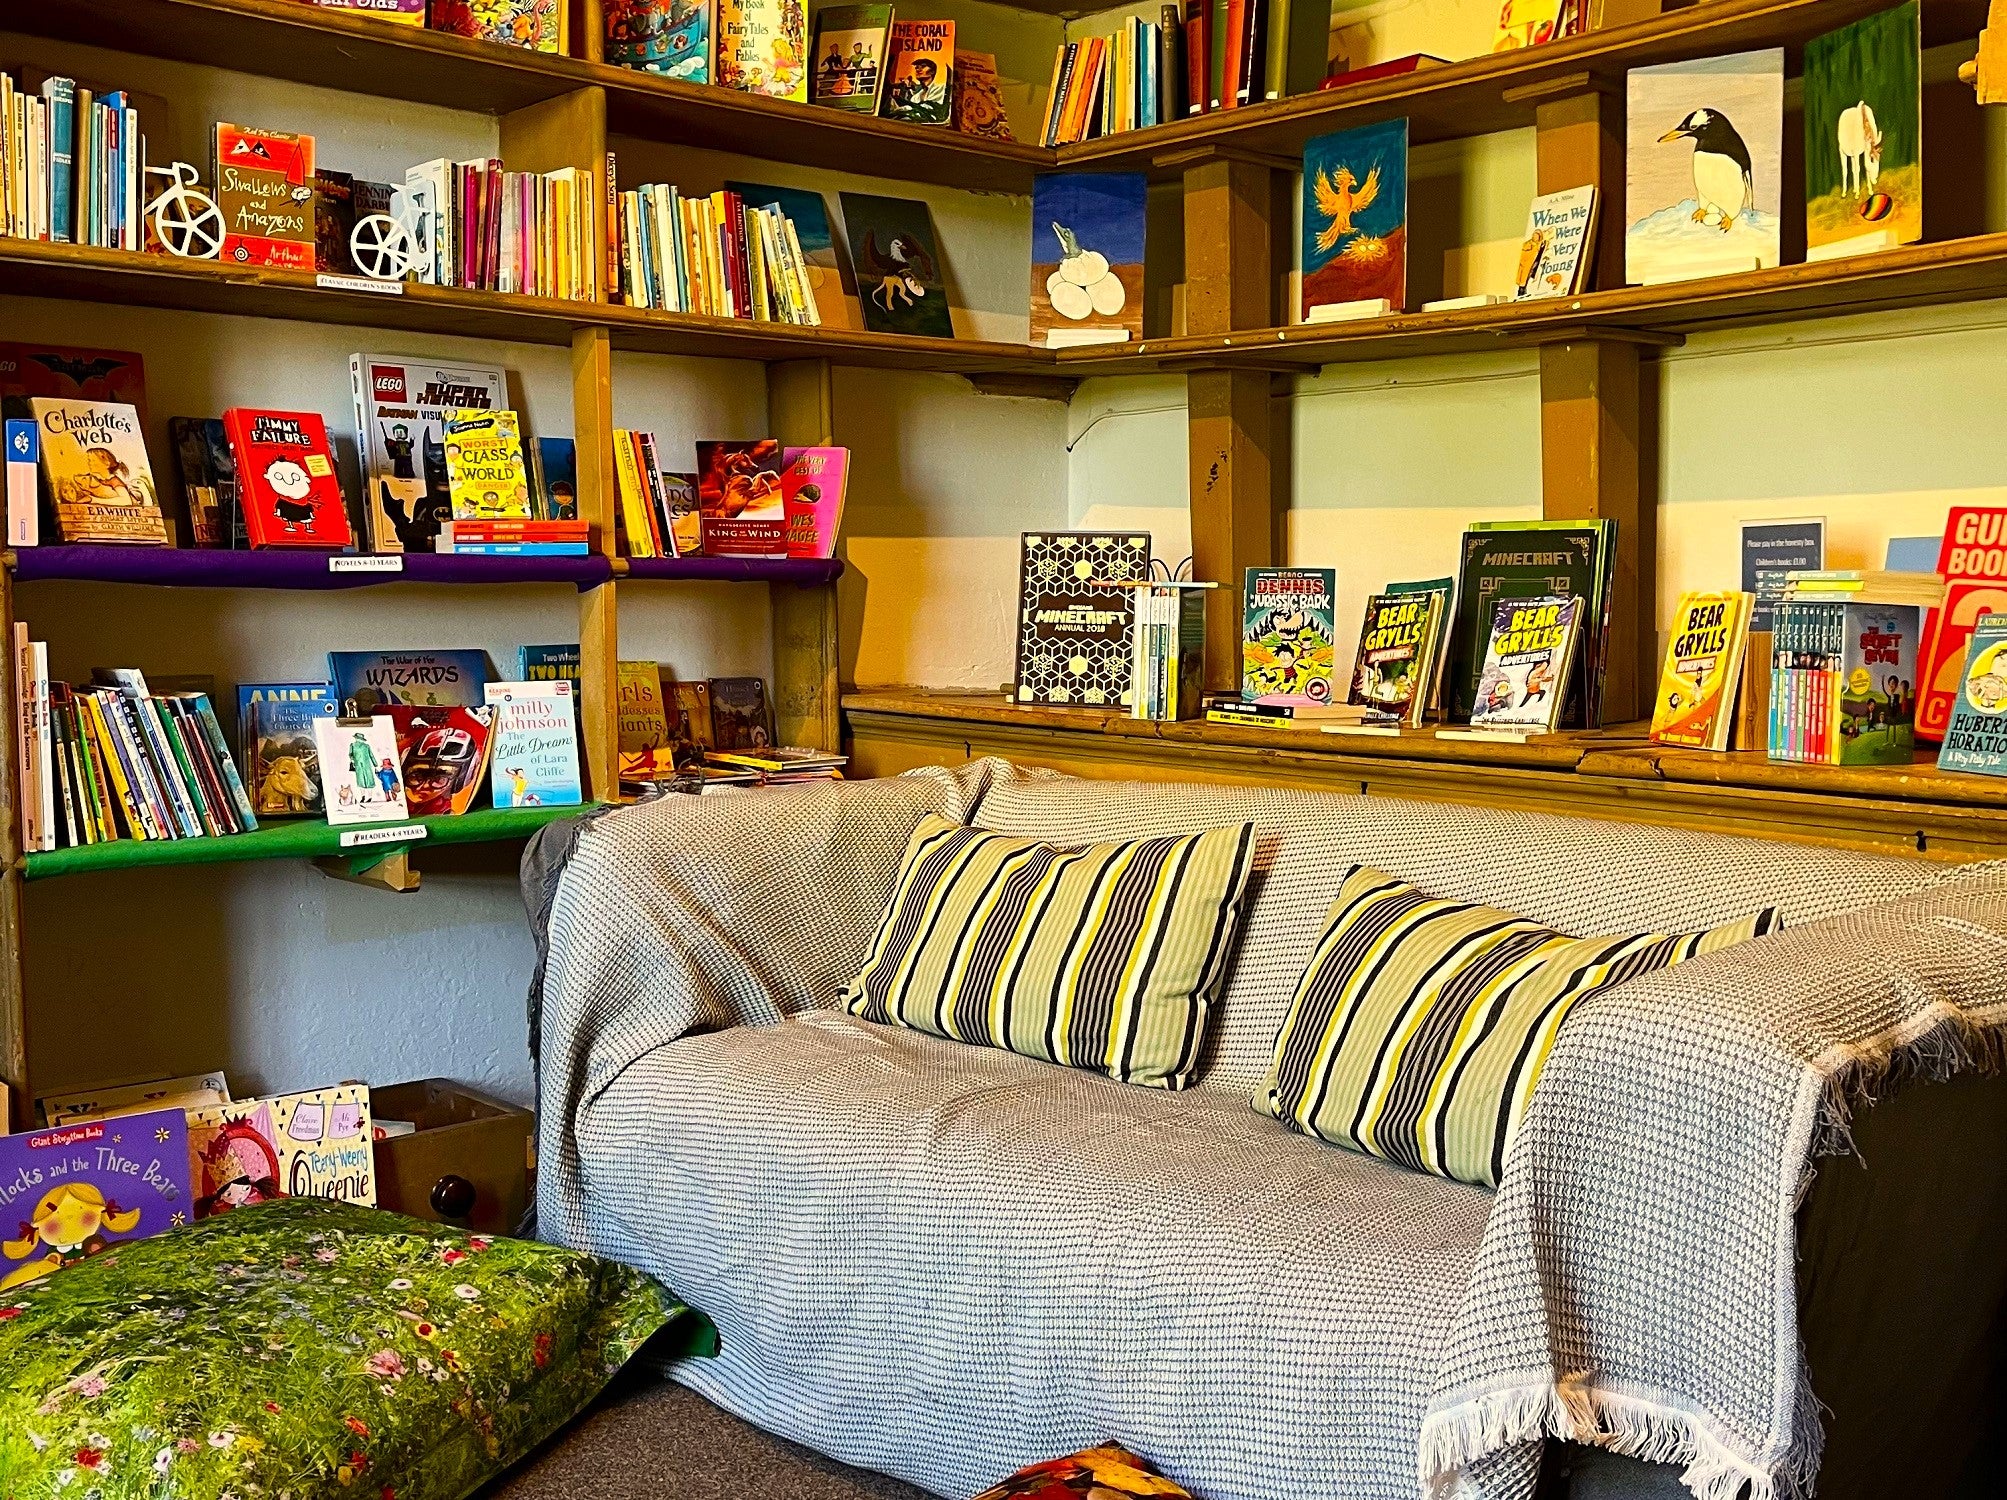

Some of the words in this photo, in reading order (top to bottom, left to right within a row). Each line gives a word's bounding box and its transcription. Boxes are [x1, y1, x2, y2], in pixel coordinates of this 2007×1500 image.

[746, 0, 765, 9] Book
[744, 10, 751, 21] of
[728, 22, 748, 37] Fairy
[749, 22, 769, 34] Tales
[893, 23, 911, 38] THE
[914, 24, 949, 38] CORAL
[741, 37, 754, 48] and
[901, 38, 943, 52] ISLAND
[735, 49, 760, 61] Fables
[606, 155, 616, 182] Dicey's
[222, 168, 287, 197] Swallows
[606, 184, 617, 205] Song
[250, 200, 267, 210] and
[236, 206, 304, 236] Amazons
[1533, 208, 1568, 227] When
[1571, 206, 1587, 220] We
[1555, 225, 1581, 240] Were
[1553, 242, 1578, 256] Very
[1540, 259, 1574, 276] Young
[375, 376, 403, 392] LEGO
[425, 382, 488, 399] SUPER
[416, 393, 492, 409] HEROES
[44, 408, 131, 434] Charlotte's
[255, 416, 299, 432] TIMMY
[71, 427, 113, 448] Web
[252, 430, 311, 445] FAILURE
[462, 439, 504, 448] WORST
[462, 448, 508, 464] CLASS
[461, 467, 514, 481] WORLD
[105, 507, 141, 517] WHITE
[791, 513, 816, 527] WES
[708, 529, 738, 537] KING
[748, 530, 781, 538] WIND
[1747, 540, 1761, 548] Please
[1482, 552, 1574, 566] MINECRAFT
[1256, 578, 1325, 595] DENNIS
[1250, 594, 1299, 609] JURASSIC
[1299, 594, 1331, 609] BARK
[1035, 609, 1128, 625] MINECRAFT
[1377, 603, 1418, 628] BEAR
[1510, 606, 1560, 631] BEAR
[1688, 603, 1725, 631] BEAR
[1054, 624, 1085, 632] ANNUAL
[1365, 622, 1421, 651] GRYLLS
[1495, 625, 1564, 655] GRYLLS
[1674, 628, 1727, 657] GRYLLS
[1860, 633, 1903, 650] SECRET
[380, 656, 395, 665] The
[395, 656, 414, 665] War
[415, 656, 422, 664] of
[542, 653, 558, 663] Two
[558, 652, 580, 663] Wheel
[1500, 651, 1551, 666] ADVENTURES
[366, 665, 459, 687] WIZARDS
[529, 665, 557, 681] TWO
[559, 664, 580, 680] HEA
[510, 701, 552, 717] milly
[272, 713, 297, 722] Three
[497, 717, 568, 735] johnson
[621, 718, 666, 735] iants,
[506, 732, 525, 740] The
[495, 743, 526, 760] Little
[528, 736, 573, 754] Dreams
[530, 755, 541, 764] of
[544, 754, 568, 763] Lara
[536, 767, 565, 777] Cliffe
[360, 831, 390, 841] READERS
[403, 828, 424, 836] YEARS
[31, 1137, 51, 1147] Giant
[52, 1132, 85, 1146] Storytime
[86, 1128, 103, 1138] Books
[51, 1158, 68, 1177] and
[72, 1156, 89, 1172] the
[95, 1147, 140, 1175] Three
[142, 1158, 181, 1201] Bears
[289, 1150, 370, 1200] Queenie
